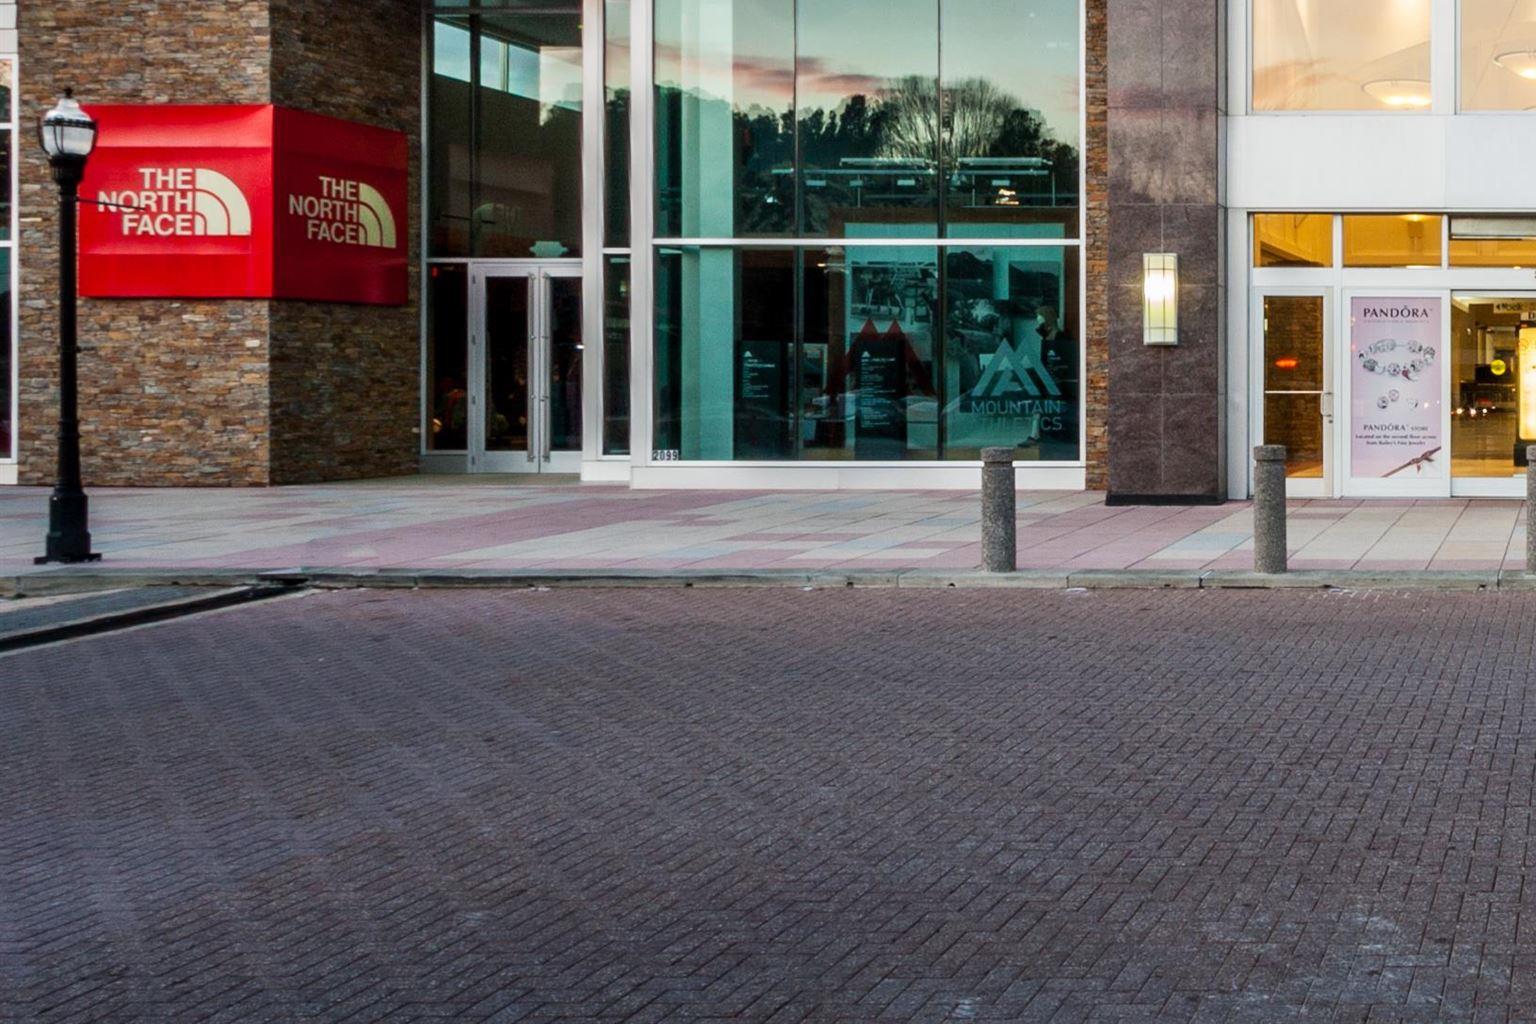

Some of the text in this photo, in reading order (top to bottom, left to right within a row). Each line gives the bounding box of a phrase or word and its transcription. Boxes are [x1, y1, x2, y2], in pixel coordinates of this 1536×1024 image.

[139, 168, 193, 189] THE
[319, 176, 357, 198] THE
[98, 191, 193, 212] NORTH
[289, 195, 357, 221] NORTH
[123, 214, 193, 236] FACE
[308, 221, 358, 245] FACE
[971, 400, 1060, 414] MOUNTAIN
